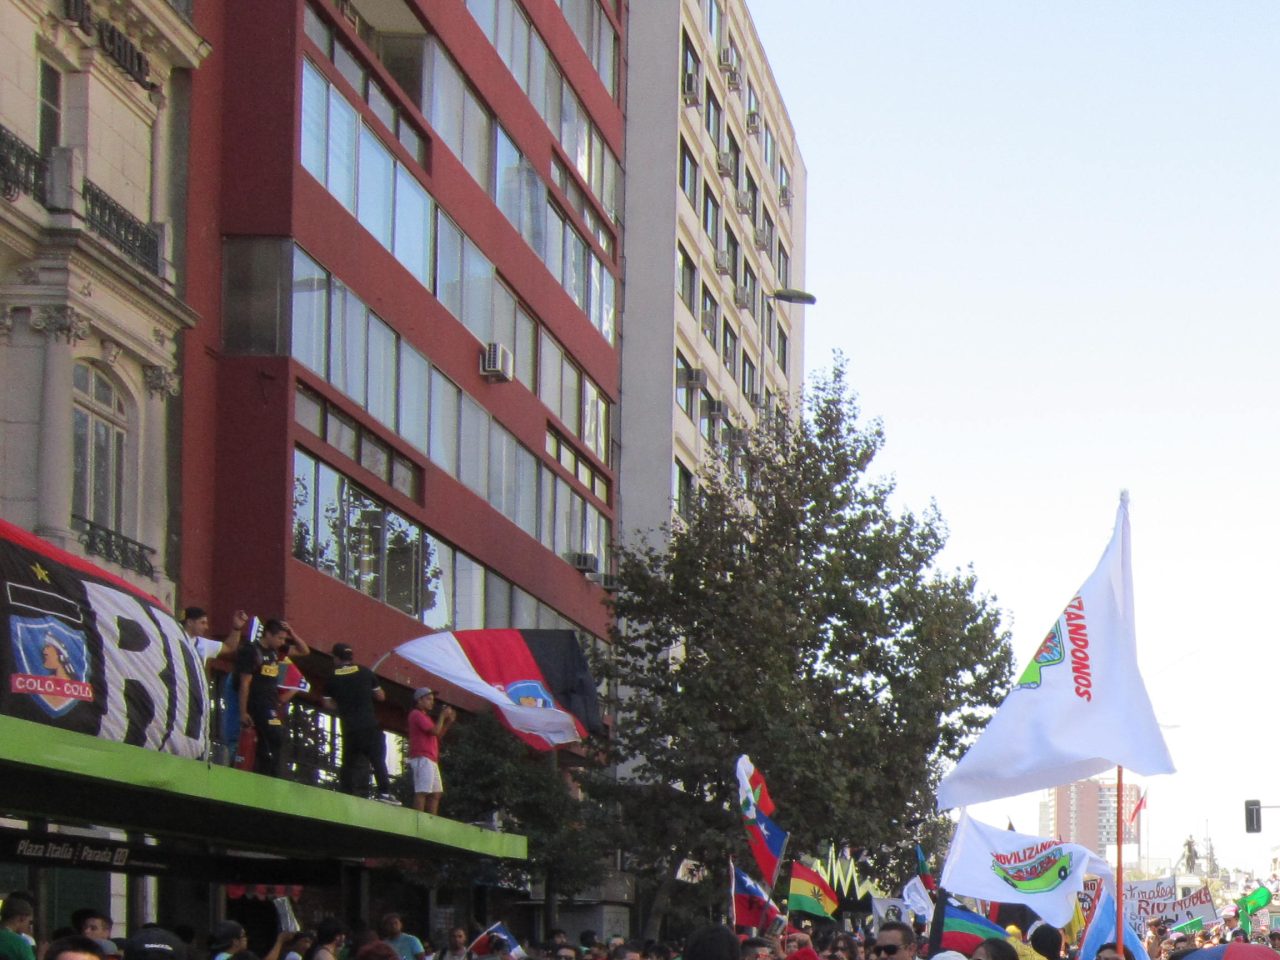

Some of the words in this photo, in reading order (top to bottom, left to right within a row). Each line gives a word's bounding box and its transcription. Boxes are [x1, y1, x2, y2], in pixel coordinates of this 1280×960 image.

[98, 17, 151, 91] CHILE
[15, 677, 54, 693] COLO
[16, 839, 44, 857] Plaza
[46, 842, 73, 860] Italia
[81, 845, 112, 863] Parada
